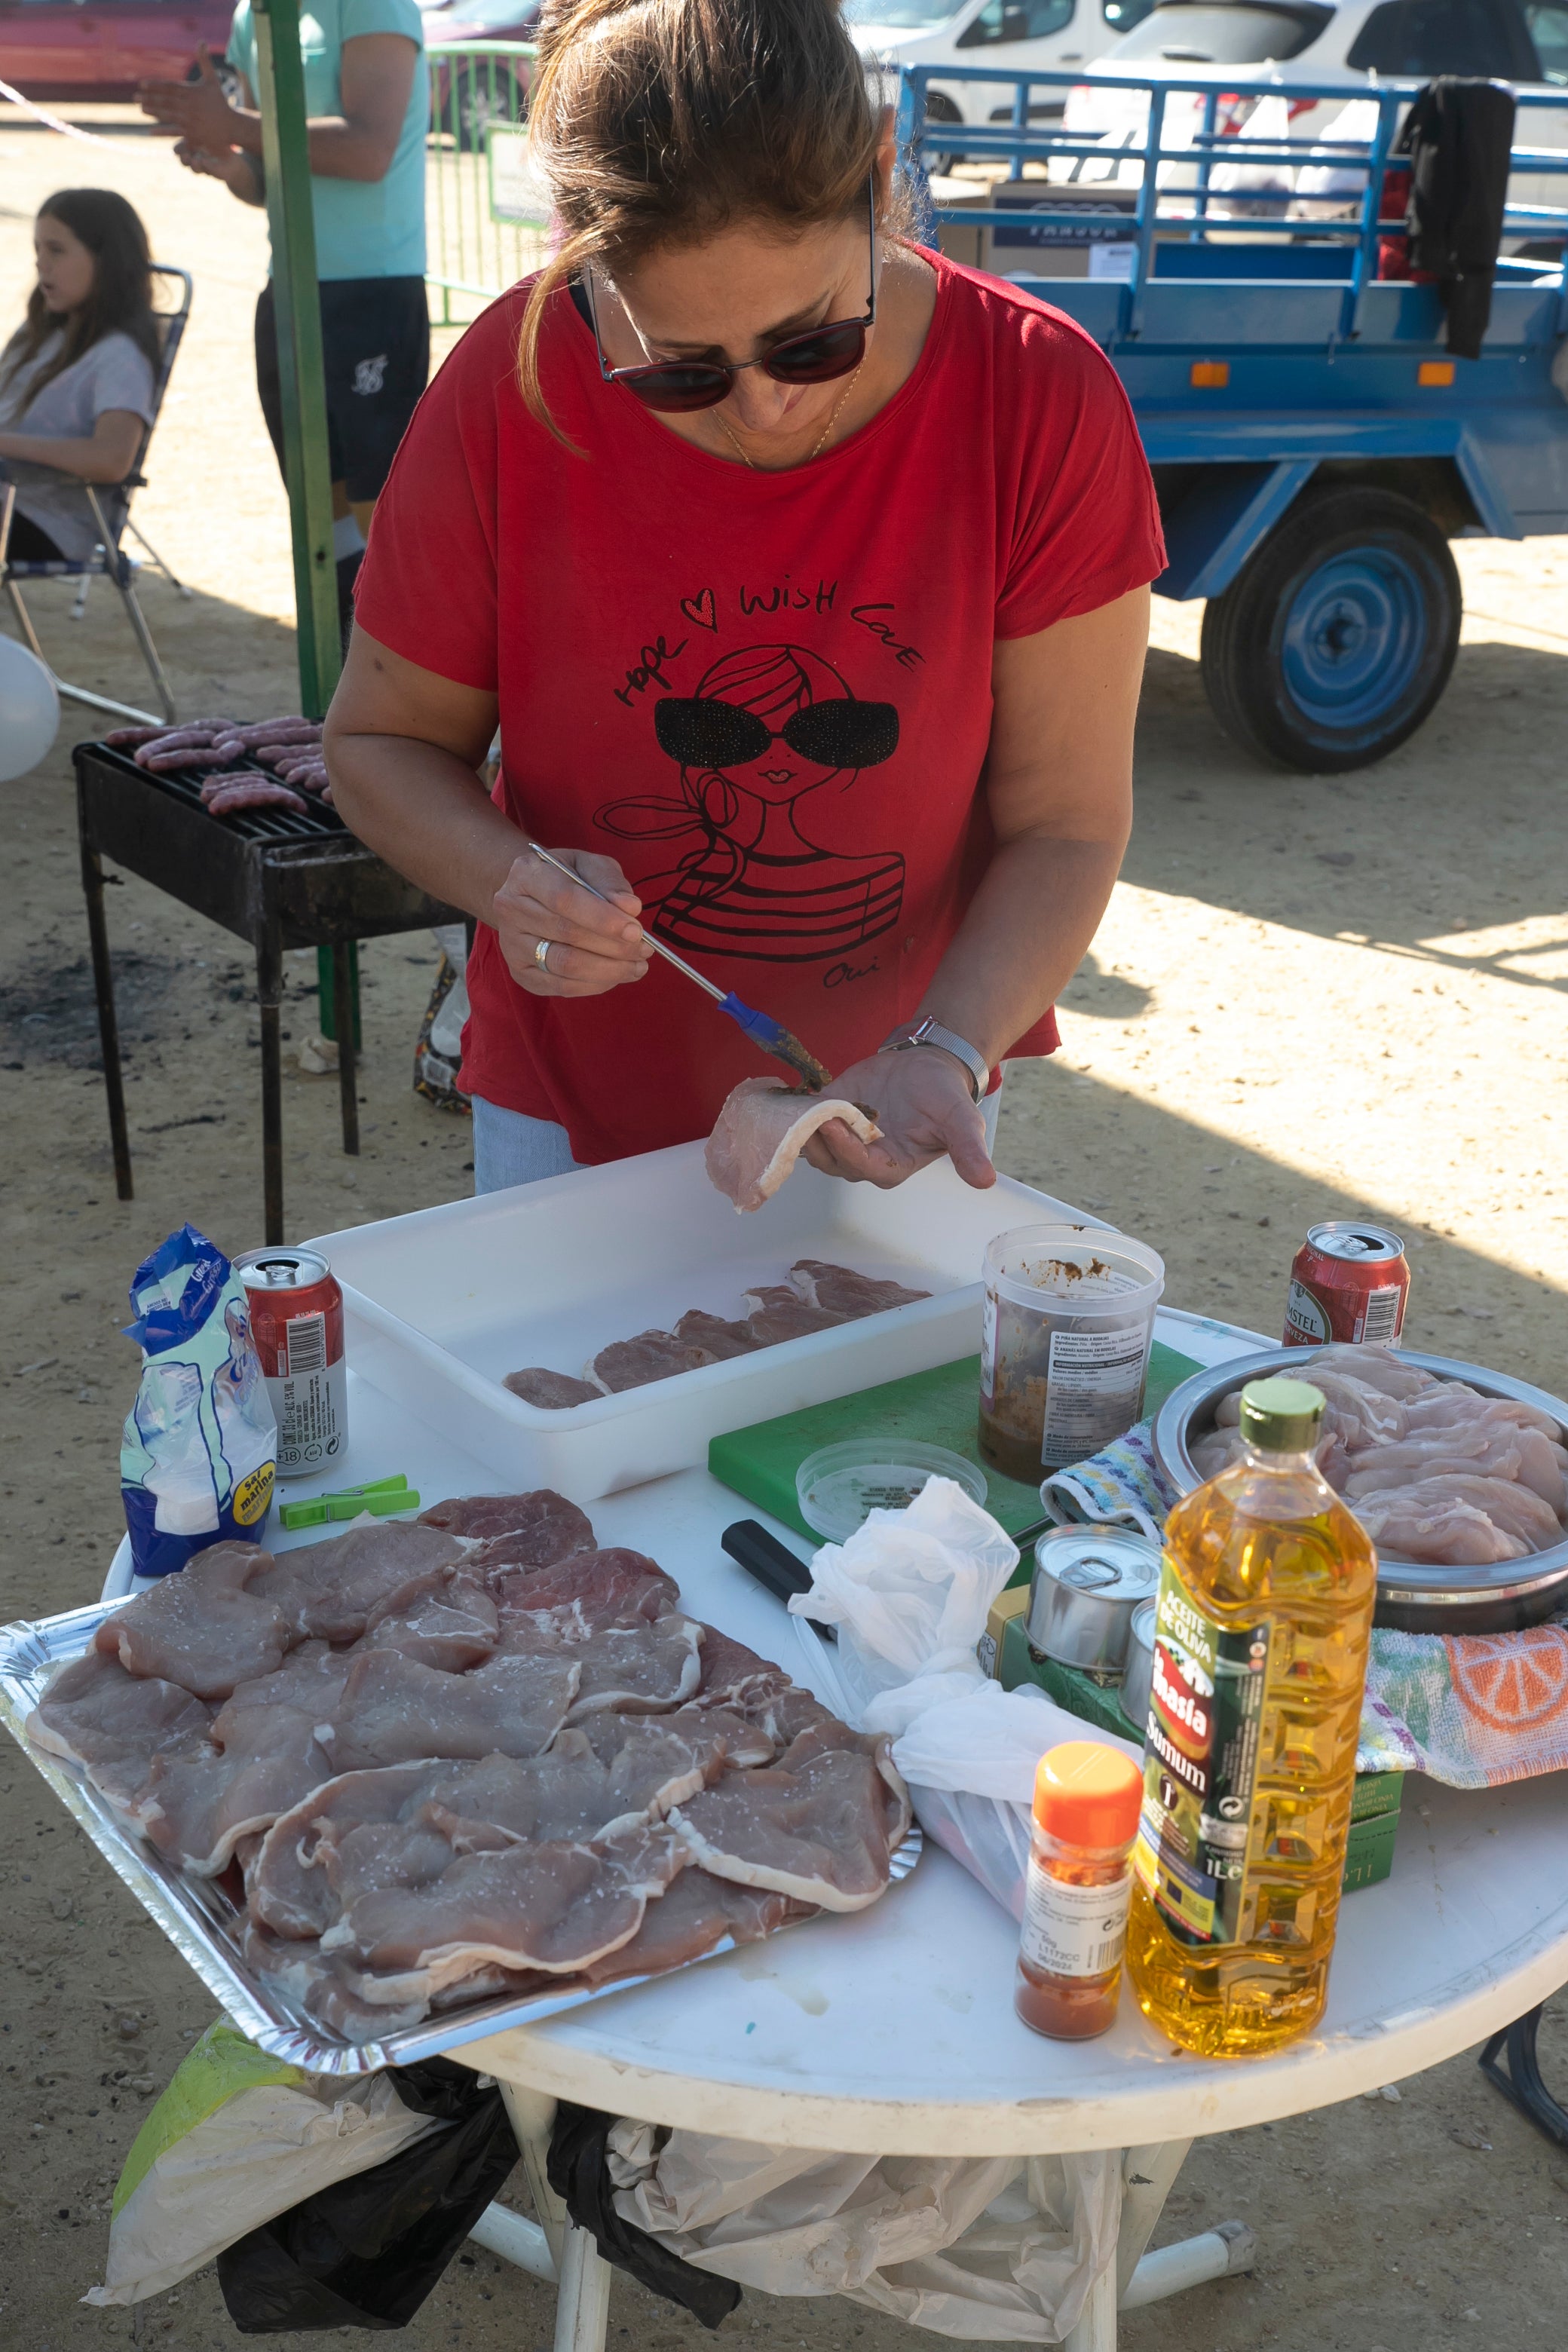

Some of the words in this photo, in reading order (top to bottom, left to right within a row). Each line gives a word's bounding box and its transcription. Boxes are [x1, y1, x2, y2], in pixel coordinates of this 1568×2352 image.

[1286, 1303, 1316, 1333] MSTEL
[1285, 1321, 1309, 1344] ERVEZA
[284, 1392, 295, 1400] 5%
[285, 1401, 295, 1410] ALC.
[282, 1431, 296, 1444] CONT.
[277, 1451, 297, 1461] +18
[240, 1470, 274, 1511] marina
[244, 1469, 261, 1490] sal
[1167, 1591, 1206, 1638] ACEITE
[1159, 1601, 1174, 1630] DE
[1174, 1620, 1211, 1663] OLIVA
[1147, 1711, 1206, 1793] Sumum
[1041, 1934, 1057, 1949] 50g
